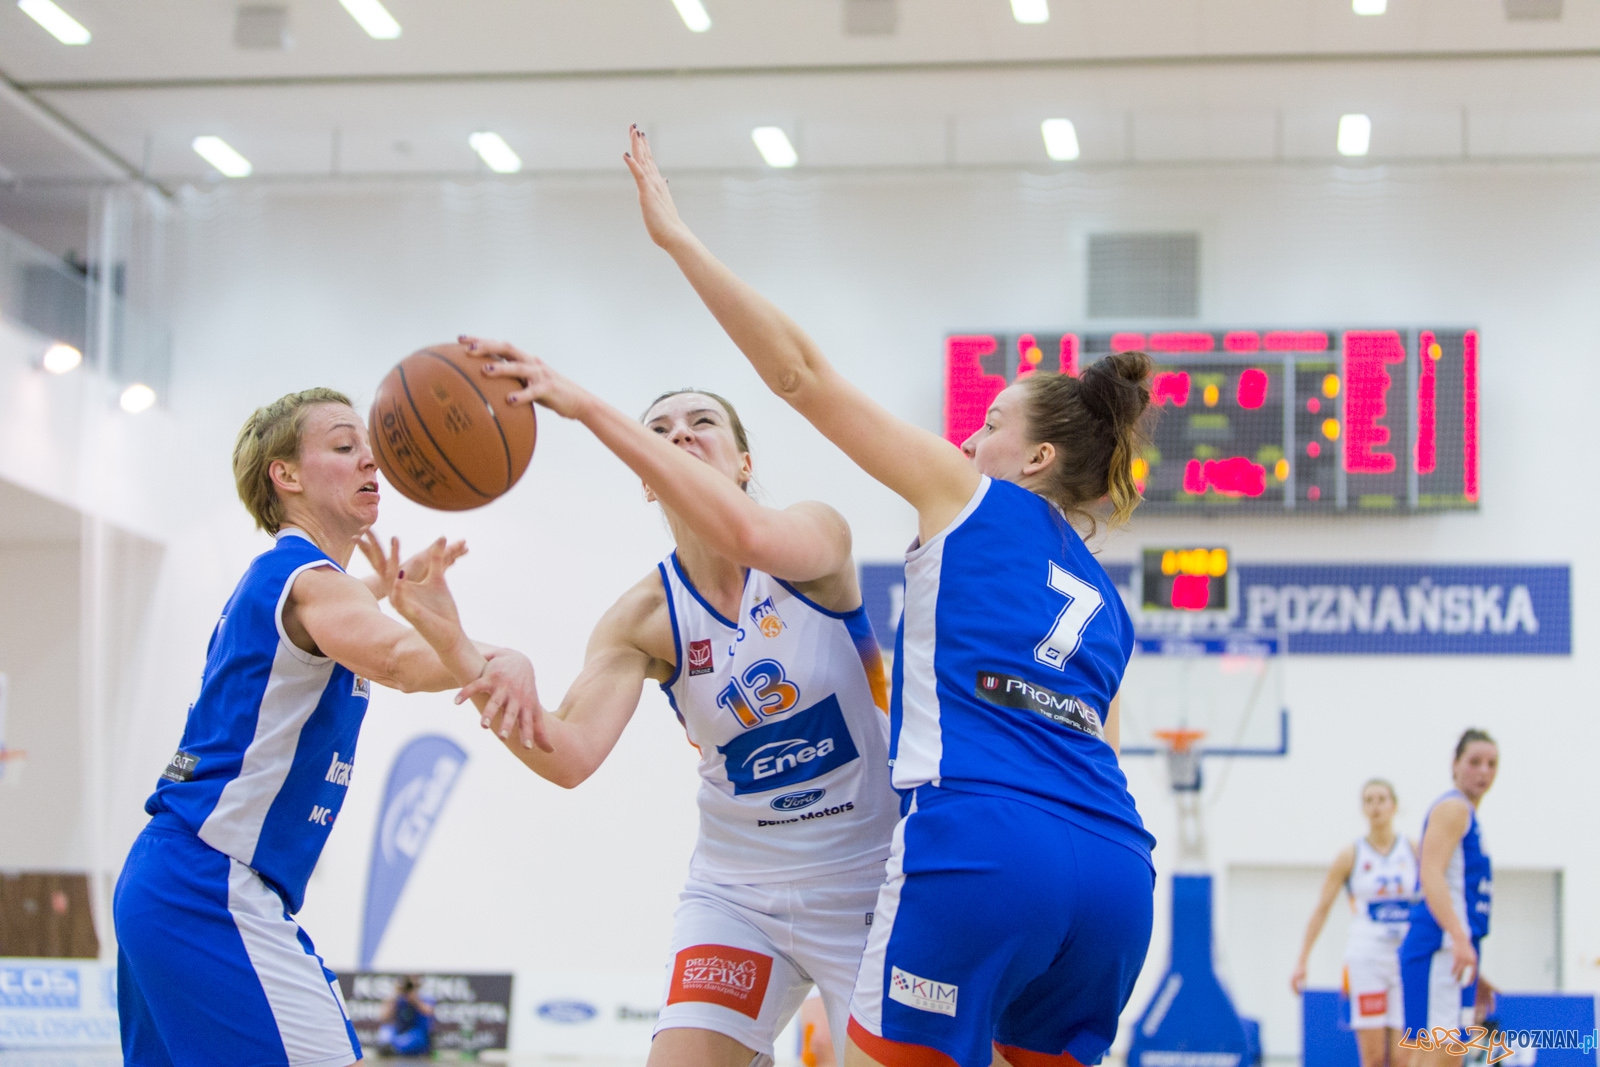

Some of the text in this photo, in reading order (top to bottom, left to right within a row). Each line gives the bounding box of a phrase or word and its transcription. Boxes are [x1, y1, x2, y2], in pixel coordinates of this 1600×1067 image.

[1034, 559, 1104, 672] 7
[1246, 576, 1540, 635] POZNAŃSKA
[716, 658, 800, 730] 13
[1039, 708, 1053, 719] THE
[752, 737, 835, 780] Enea
[782, 792, 816, 808] Ford
[800, 801, 854, 821] Motors
[685, 955, 745, 974] DRUŻYNA
[682, 966, 757, 991] SZPIKU
[912, 977, 956, 1003] KIM
